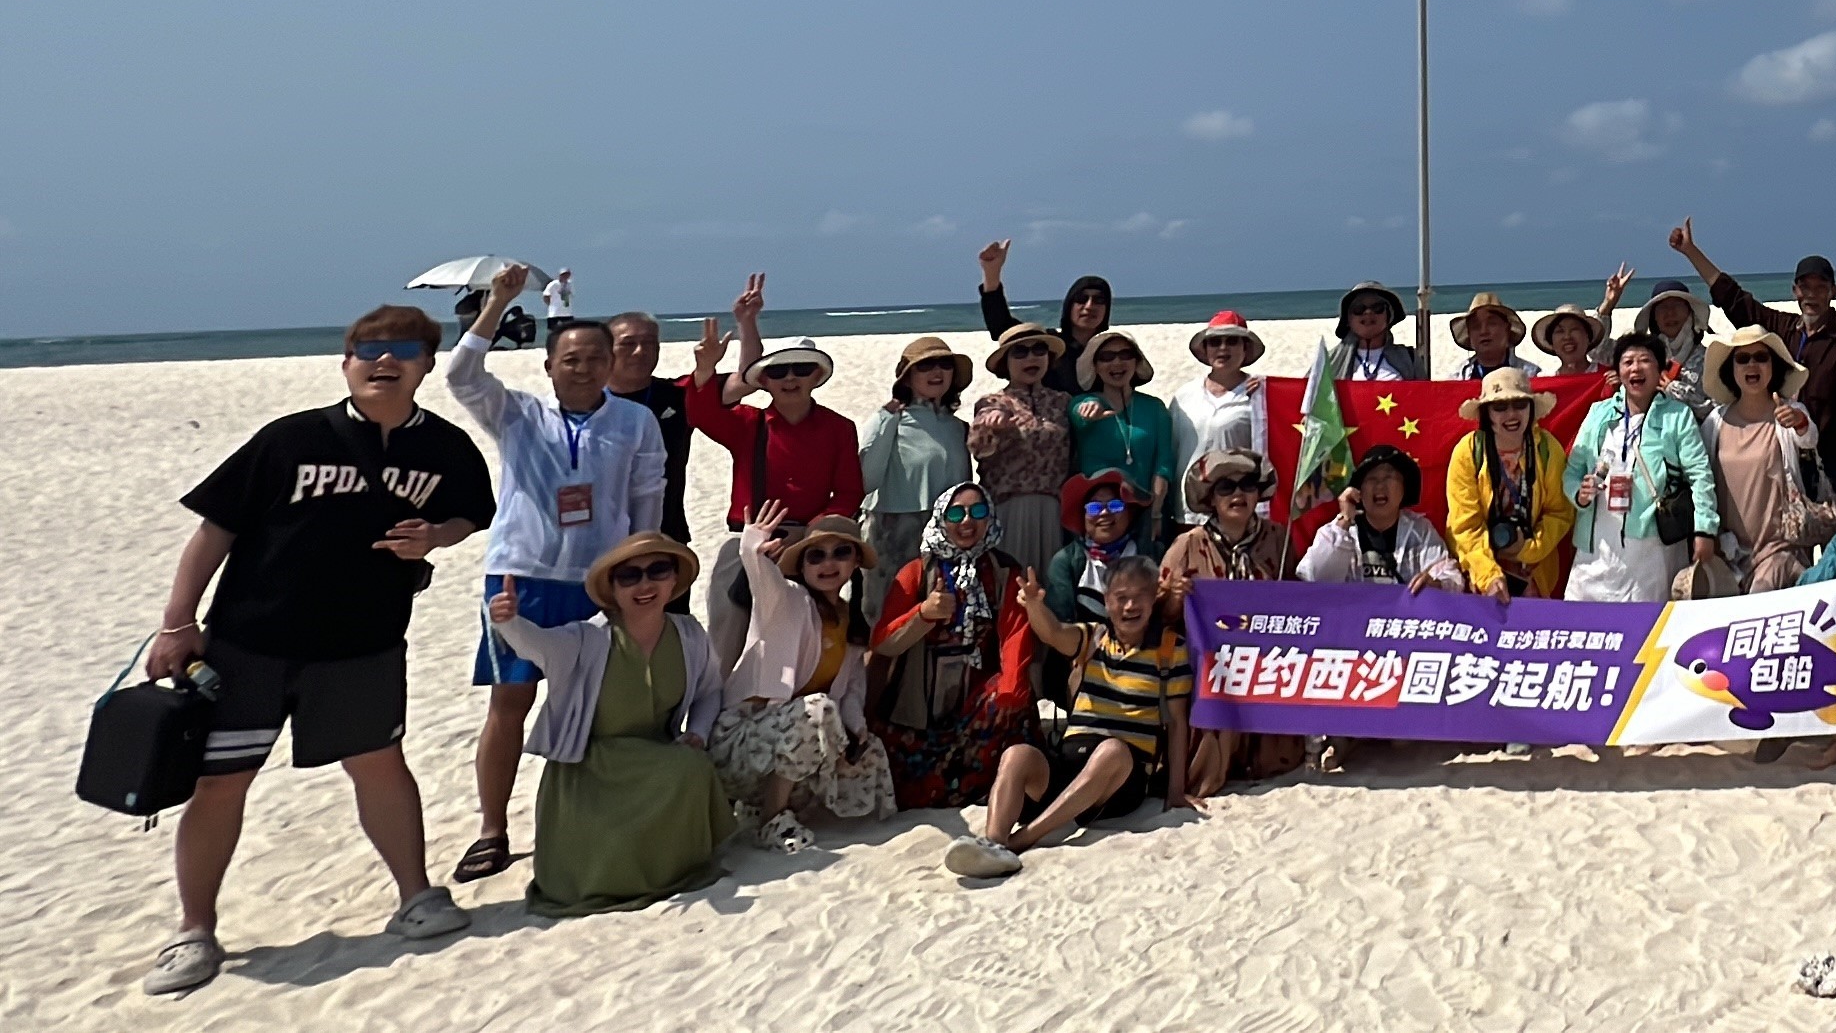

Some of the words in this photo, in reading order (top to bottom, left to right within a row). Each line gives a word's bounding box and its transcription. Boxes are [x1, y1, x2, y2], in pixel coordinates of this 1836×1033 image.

[1249, 614, 1321, 636] 同程旅行
[1365, 618, 1489, 644] 南海芳华中国心
[1496, 630, 1624, 651] 西沙漫行爱国情
[1721, 611, 1804, 663] 同程
[1208, 644, 1621, 711] 相约西沙圆梦起航！
[1750, 655, 1813, 693] 包船
